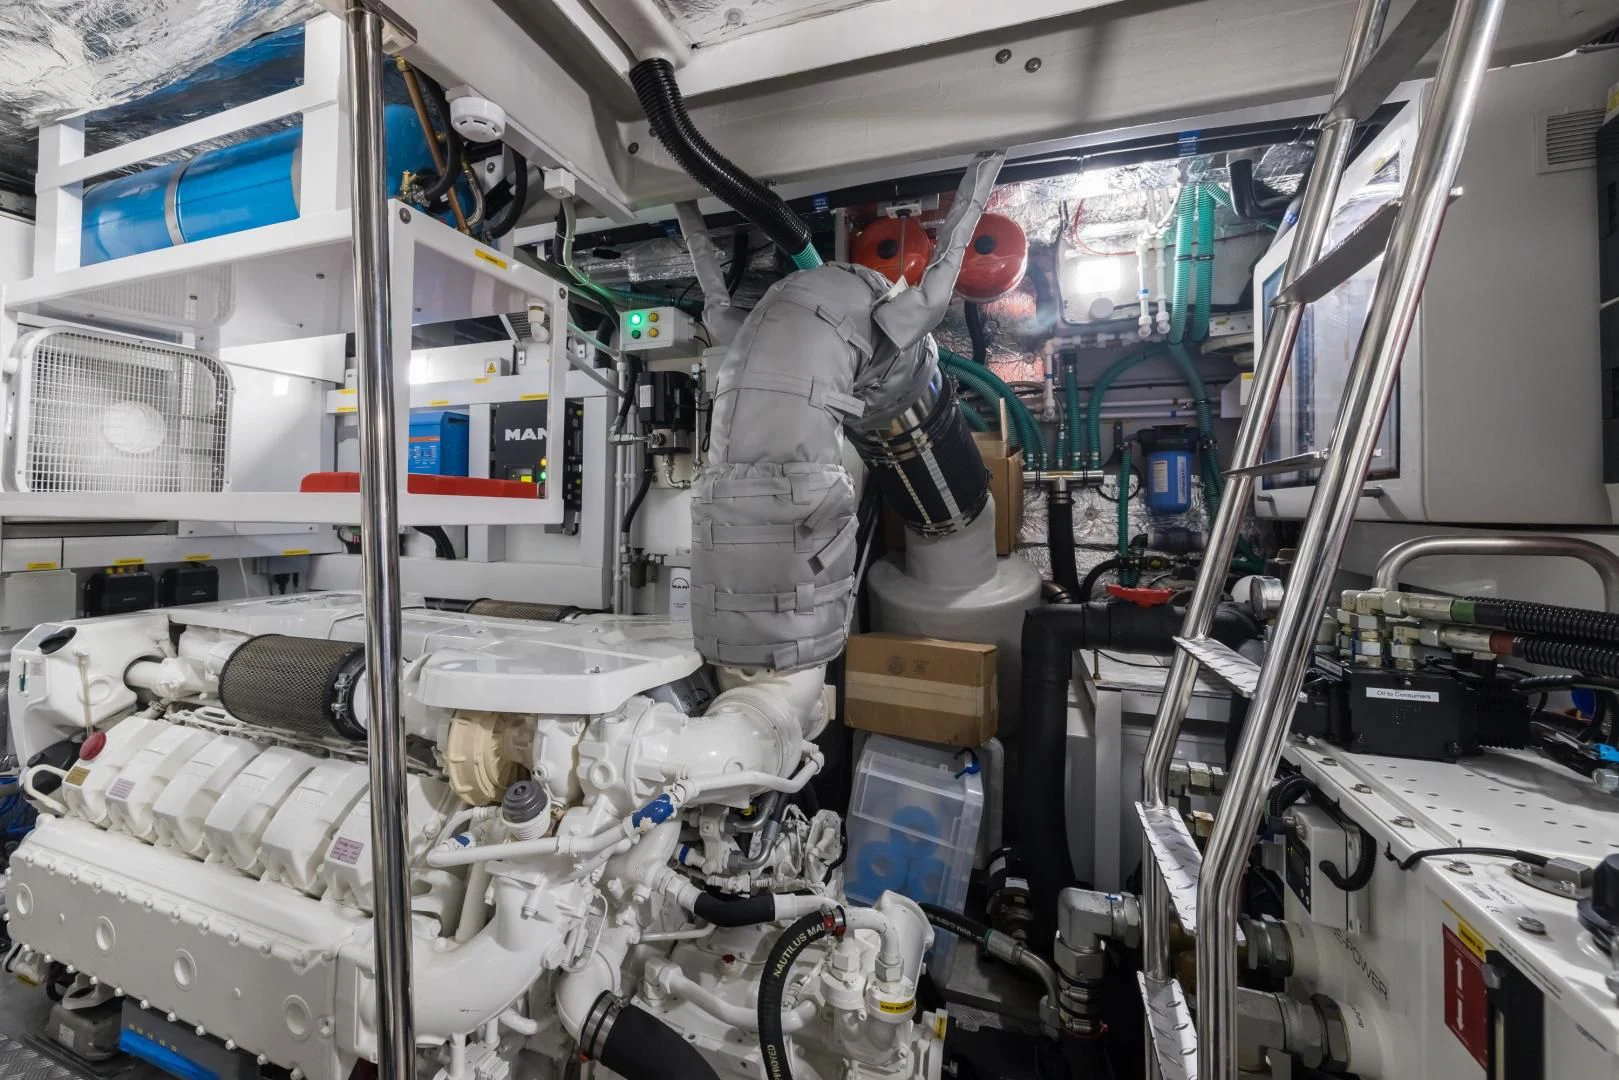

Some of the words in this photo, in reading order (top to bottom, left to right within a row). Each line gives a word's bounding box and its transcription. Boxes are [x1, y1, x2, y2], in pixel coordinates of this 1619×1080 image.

[504, 427, 547, 441] MAN
[1395, 691, 1432, 700] Consumers
[773, 932, 807, 977] NAUTILUS
